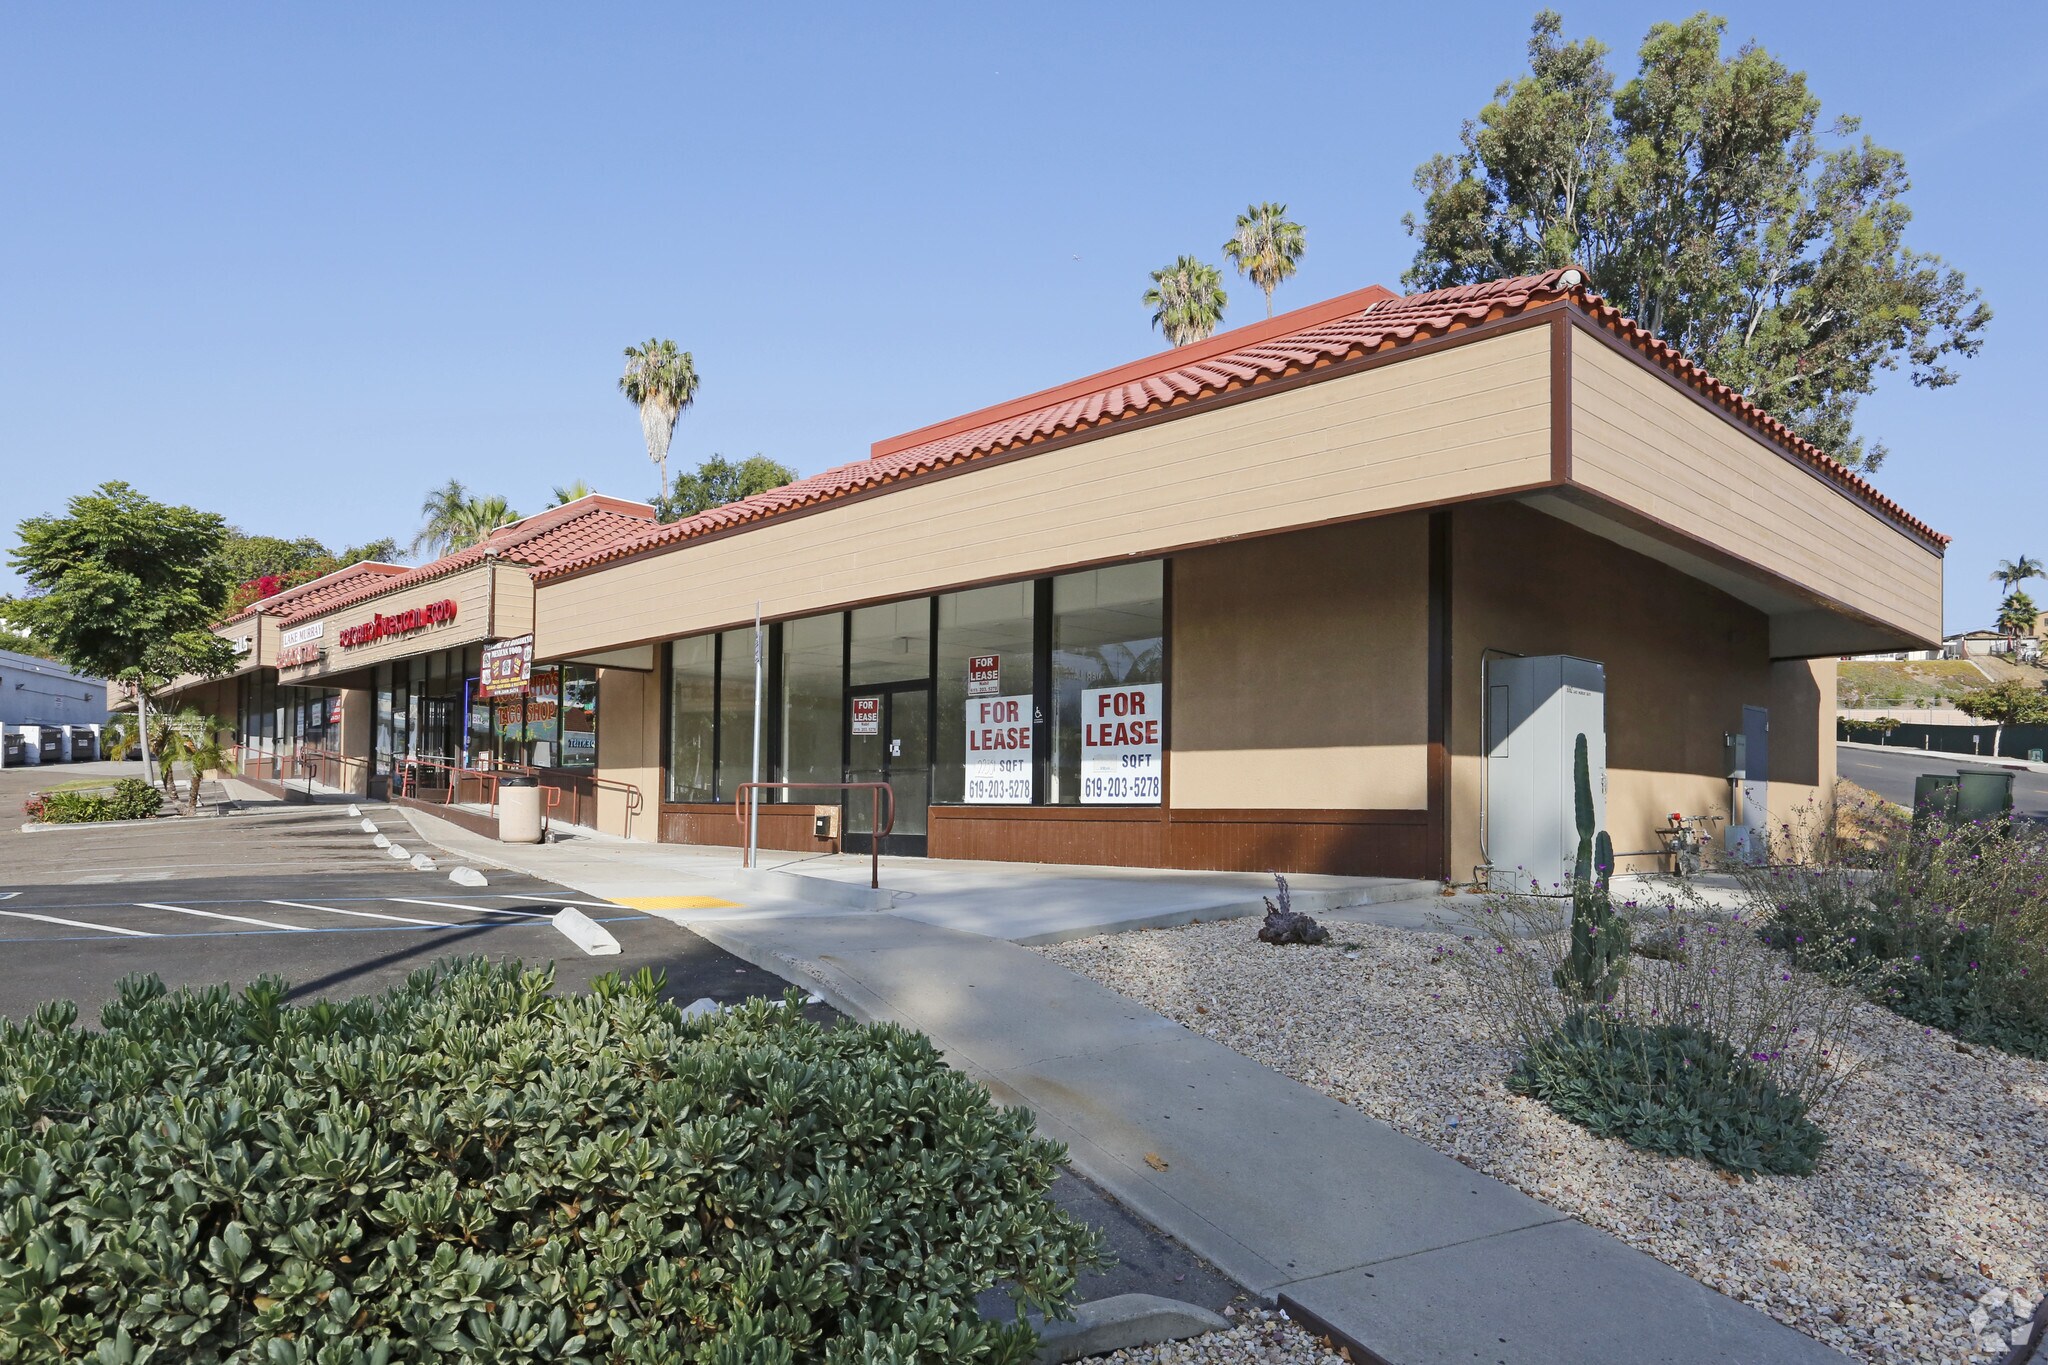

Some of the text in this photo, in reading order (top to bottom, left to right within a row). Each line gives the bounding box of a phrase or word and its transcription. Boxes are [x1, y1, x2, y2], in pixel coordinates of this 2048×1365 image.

[284, 624, 322, 645] LAKE MURRAY
[975, 657, 993, 668] FOR
[970, 670, 998, 681] LEASE
[496, 703, 523, 725] TACO
[526, 701, 557, 722] SHOP
[858, 701, 873, 710] FOR
[980, 701, 1019, 724] FOR
[1098, 691, 1145, 718] FOR
[854, 713, 877, 721] LEASE
[970, 727, 1030, 751] LEASE
[1085, 720, 1158, 747] LEASE
[1000, 760, 1024, 772] SQFT
[1122, 754, 1152, 768] SQFT
